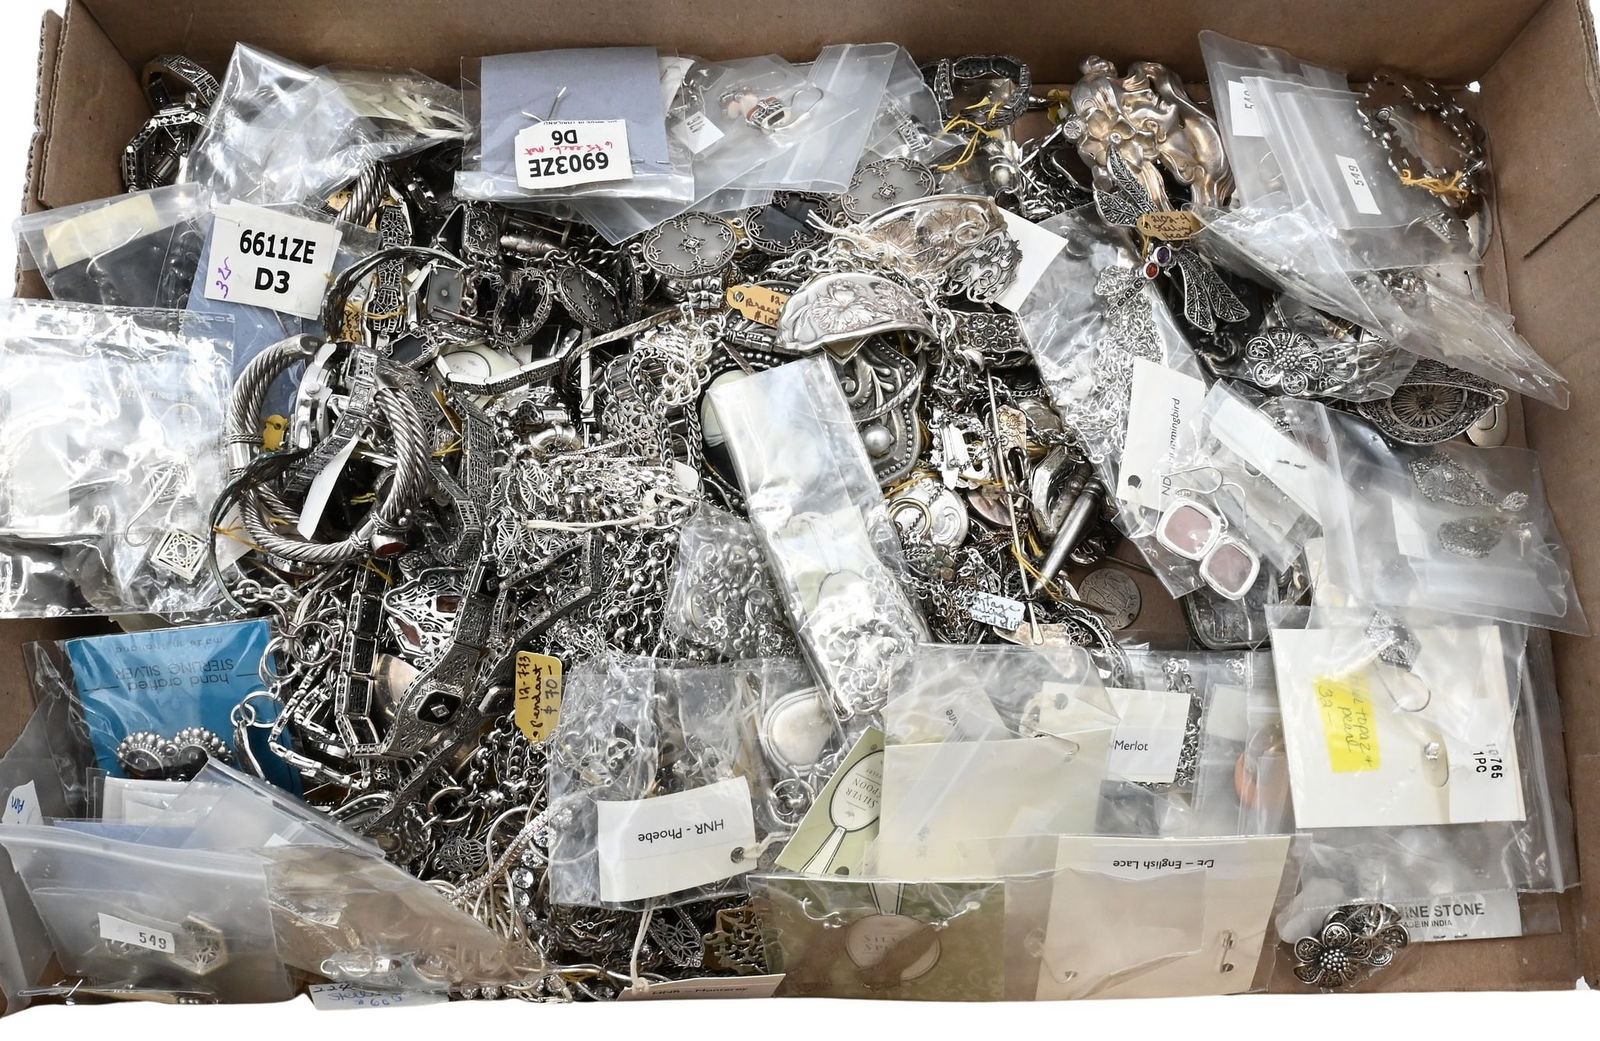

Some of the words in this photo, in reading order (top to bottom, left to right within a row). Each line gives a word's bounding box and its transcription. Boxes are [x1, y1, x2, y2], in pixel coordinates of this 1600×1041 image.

[550, 129, 578, 146] D6
[528, 152, 609, 178] 6903ZE
[1348, 164, 1365, 187] 549
[239, 229, 316, 265] 6611ZE
[254, 266, 291, 294] D3
[115, 664, 161, 680] SILVER
[168, 658, 234, 676] STERLING
[189, 673, 230, 687] hand
[1114, 740, 1149, 751] Merlot
[1472, 750, 1488, 774] 1PC
[845, 786, 879, 809] SILVER
[637, 824, 683, 843] Phoebe
[695, 818, 725, 835] HNR
[1112, 860, 1139, 870] Lace
[1143, 858, 1182, 870] English
[1433, 902, 1484, 917] STONE
[138, 932, 167, 949] 549
